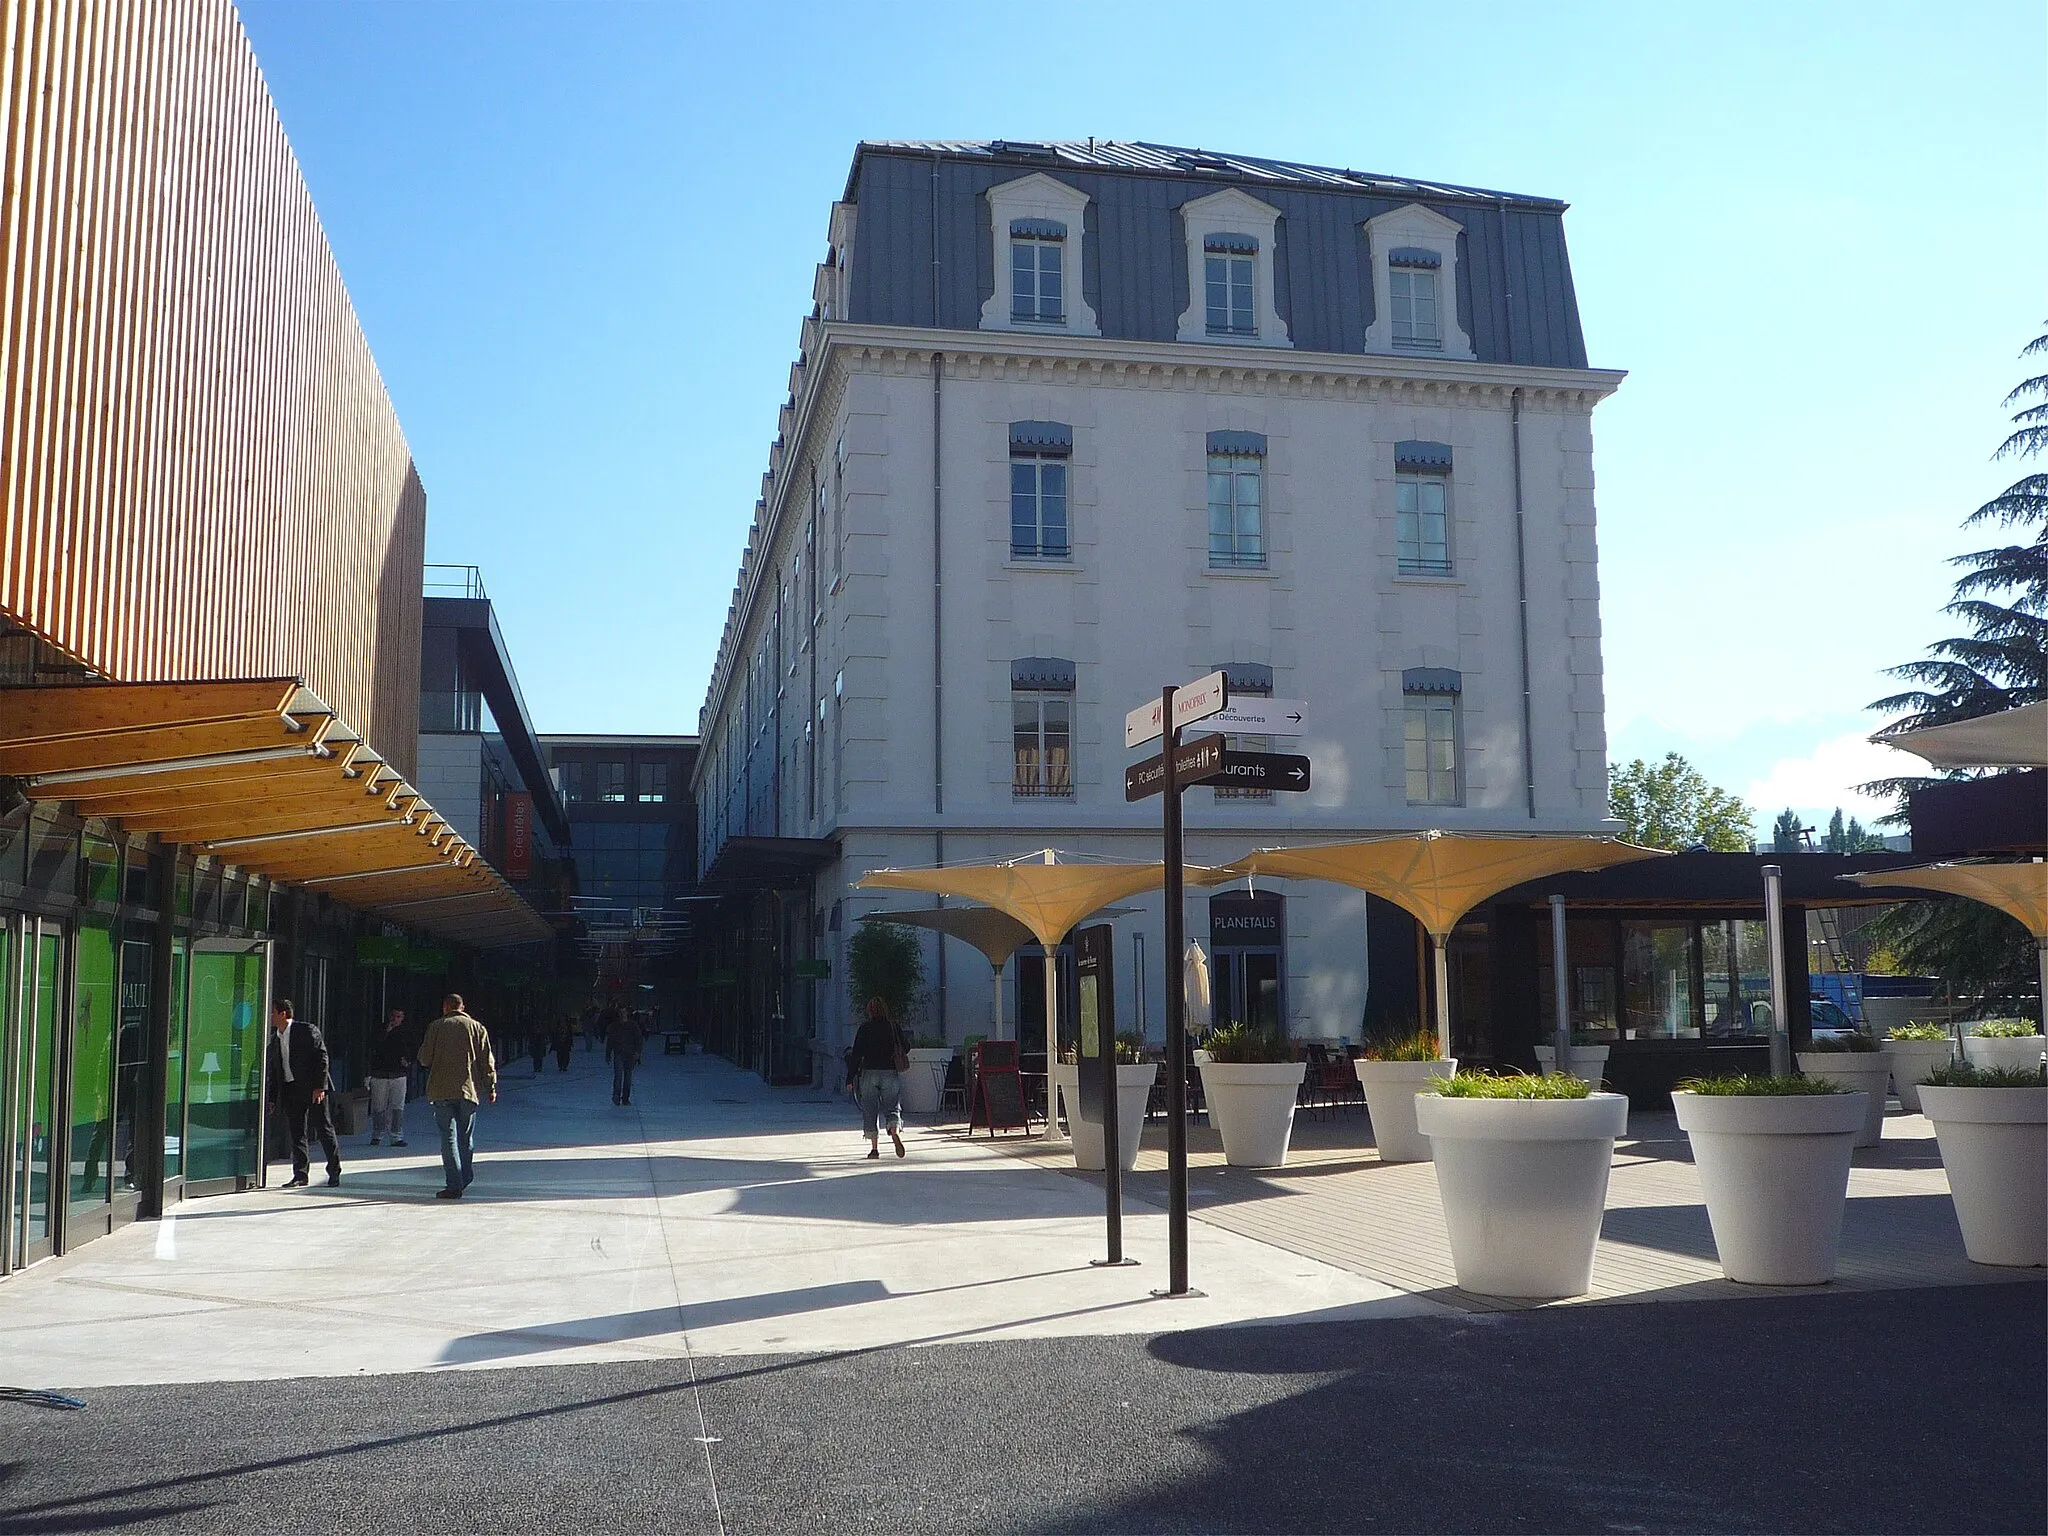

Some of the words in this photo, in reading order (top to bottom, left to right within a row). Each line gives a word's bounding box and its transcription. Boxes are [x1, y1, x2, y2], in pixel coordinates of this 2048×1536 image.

[1219, 713, 1266, 723] Découvertes
[1225, 764, 1266, 777] urants
[1214, 916, 1276, 929] PLANETALIS
[121, 982, 147, 1008] PAUL
